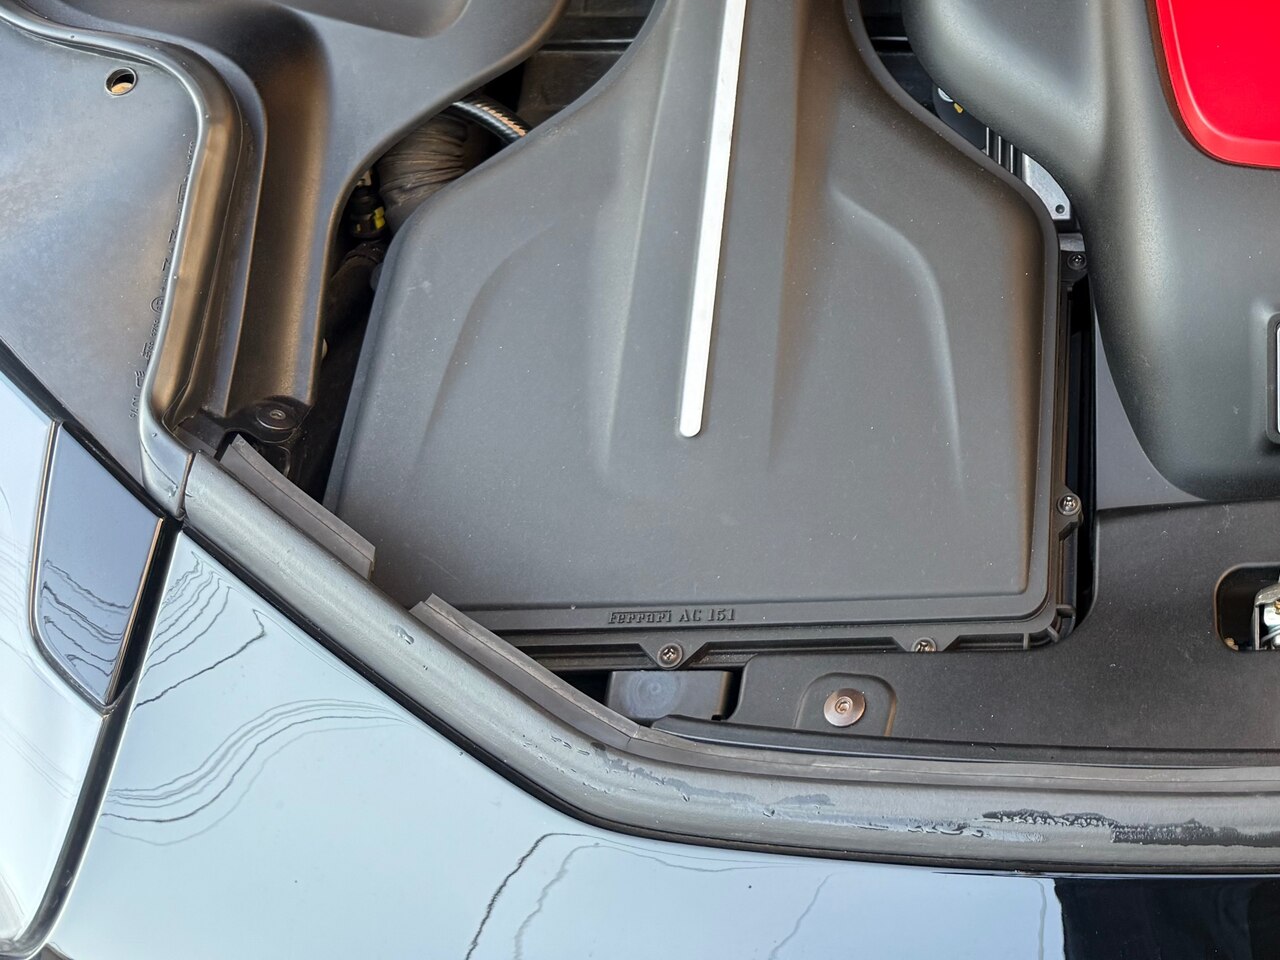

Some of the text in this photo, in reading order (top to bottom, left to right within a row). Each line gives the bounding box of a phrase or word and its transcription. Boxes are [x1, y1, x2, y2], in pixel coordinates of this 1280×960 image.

[608, 608, 736, 624] Ferrari AC 151
